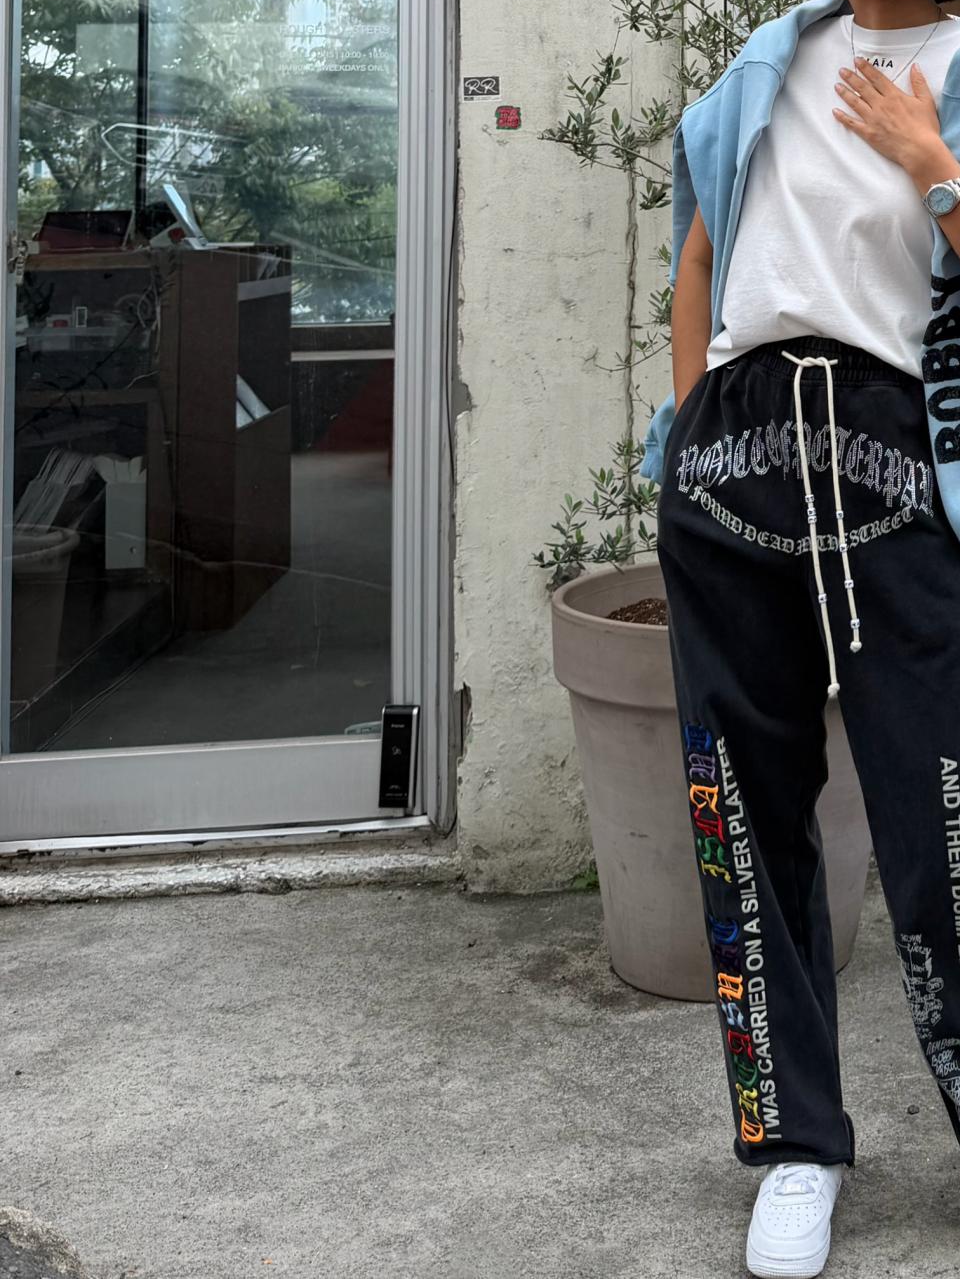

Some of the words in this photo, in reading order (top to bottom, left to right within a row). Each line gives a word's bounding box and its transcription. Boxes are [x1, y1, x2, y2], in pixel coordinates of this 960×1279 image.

[689, 485, 743, 534] FOUND
[742, 522, 795, 554] DEAD
[849, 505, 914, 549] STREET
[716, 736, 747, 835] PLATTER
[732, 839, 759, 913] SILVER
[744, 917, 761, 934] A
[745, 939, 765, 971] ON
[748, 976, 774, 1074] CARRIED
[759, 1078, 781, 1129] WAS
